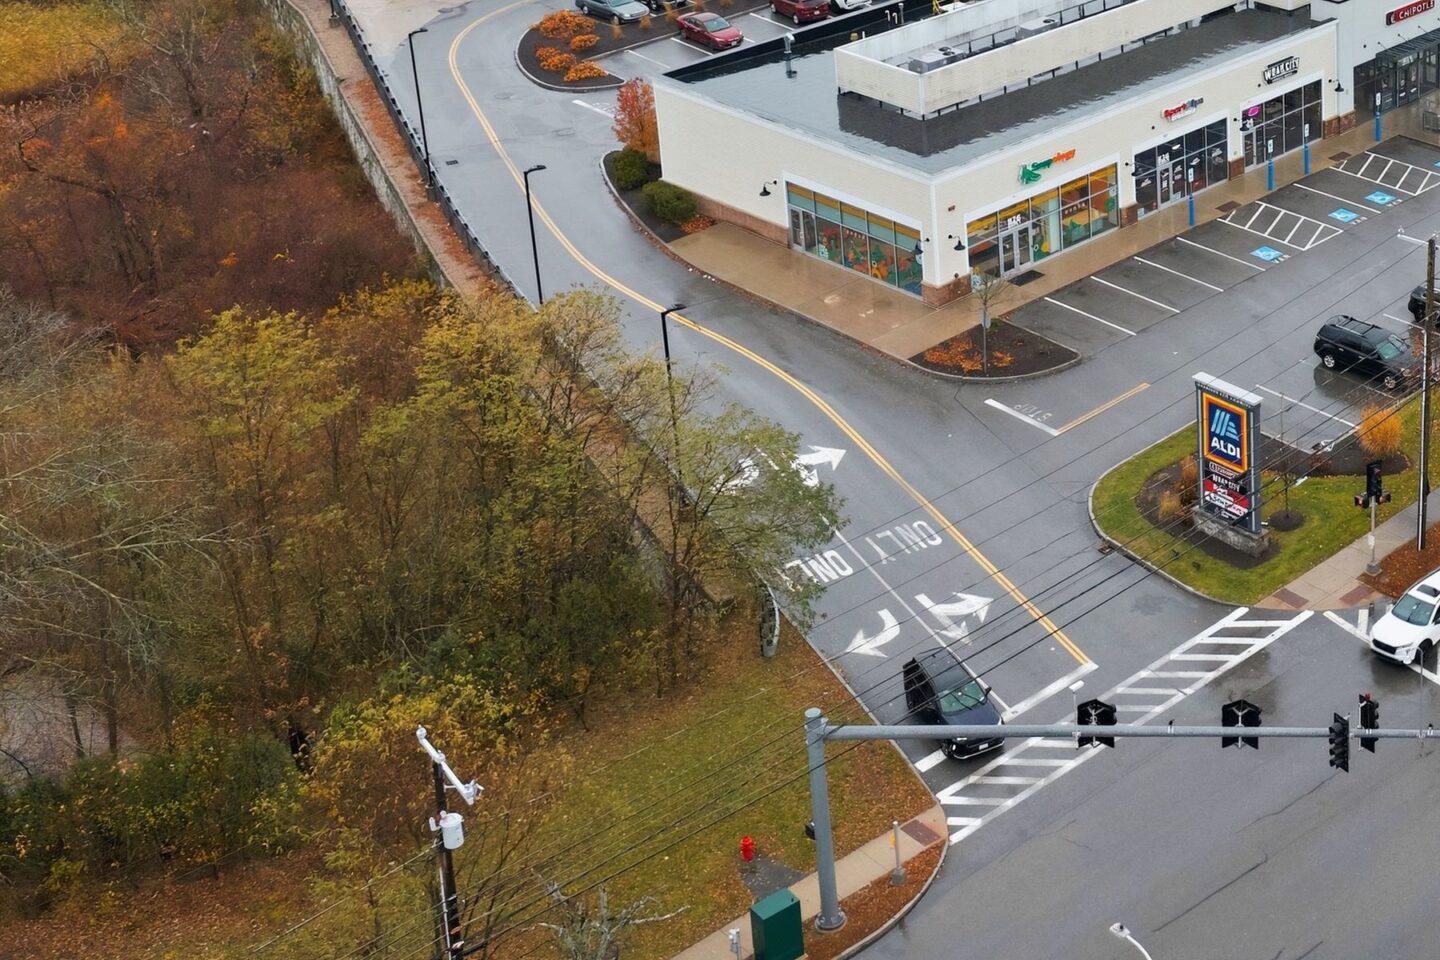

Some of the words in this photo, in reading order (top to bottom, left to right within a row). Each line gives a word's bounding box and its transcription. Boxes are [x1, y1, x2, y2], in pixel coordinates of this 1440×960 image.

[1398, 0, 1435, 20] CHIPOTLE
[1210, 436, 1241, 460] ALDI
[864, 520, 943, 565] ONLY
